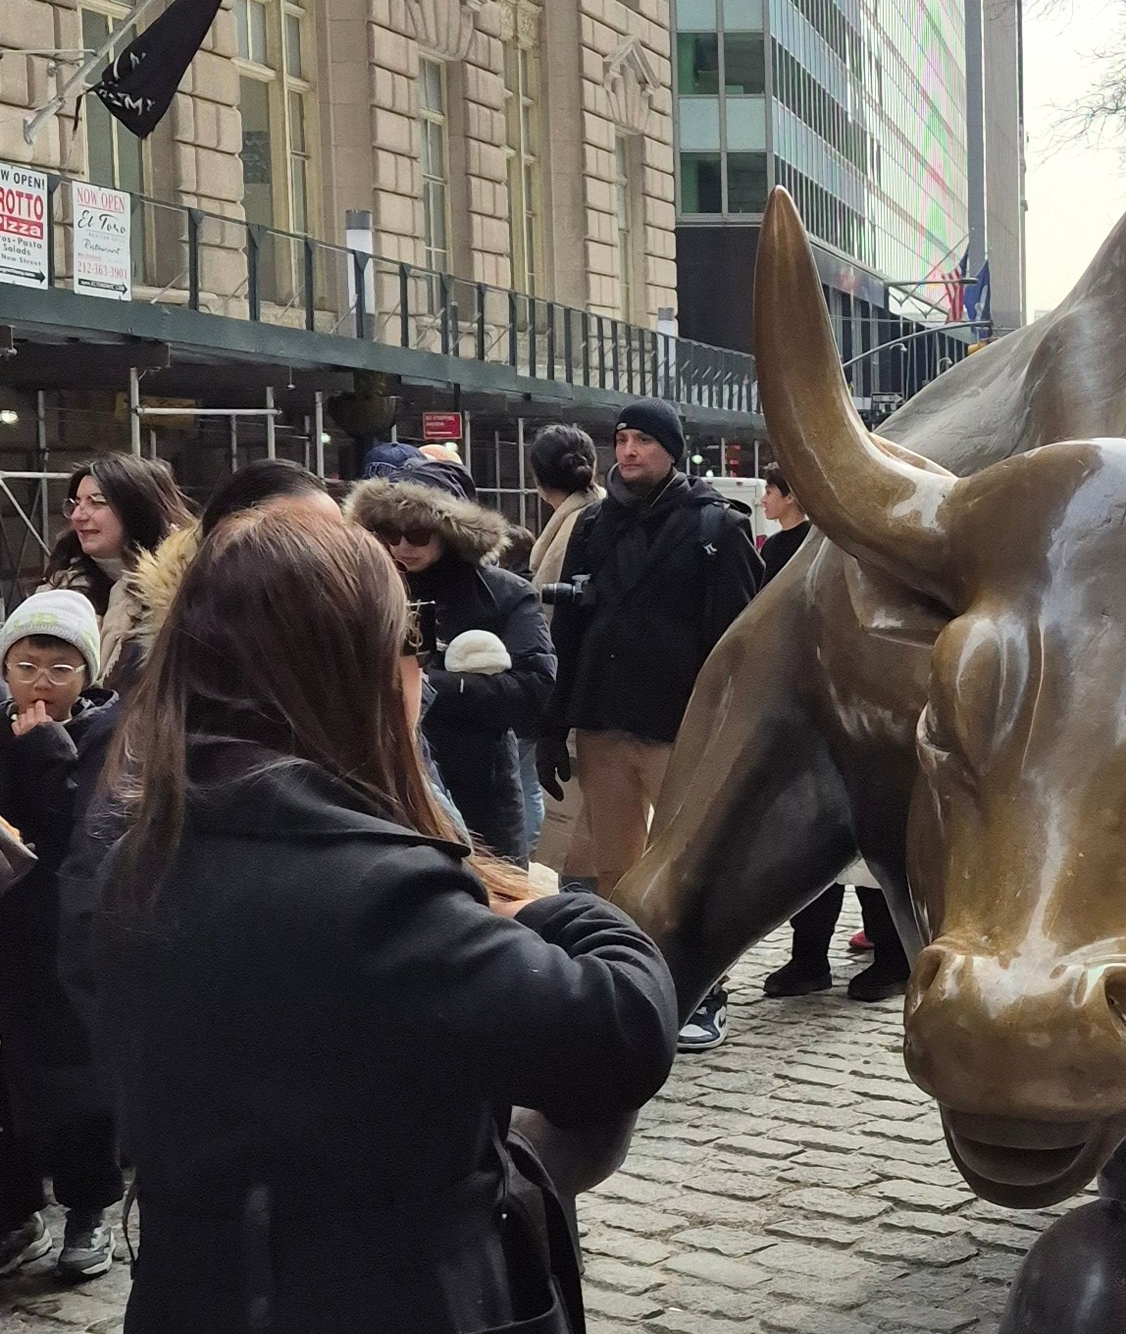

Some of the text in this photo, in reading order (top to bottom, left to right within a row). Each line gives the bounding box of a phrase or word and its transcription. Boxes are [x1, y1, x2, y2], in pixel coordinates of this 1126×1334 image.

[13, 172, 45, 190] OPEN!
[77, 187, 125, 212] NOW OPEN
[77, 210, 127, 234] El Toro
[3, 243, 31, 256] Salads
[18, 237, 42, 249] Pasta
